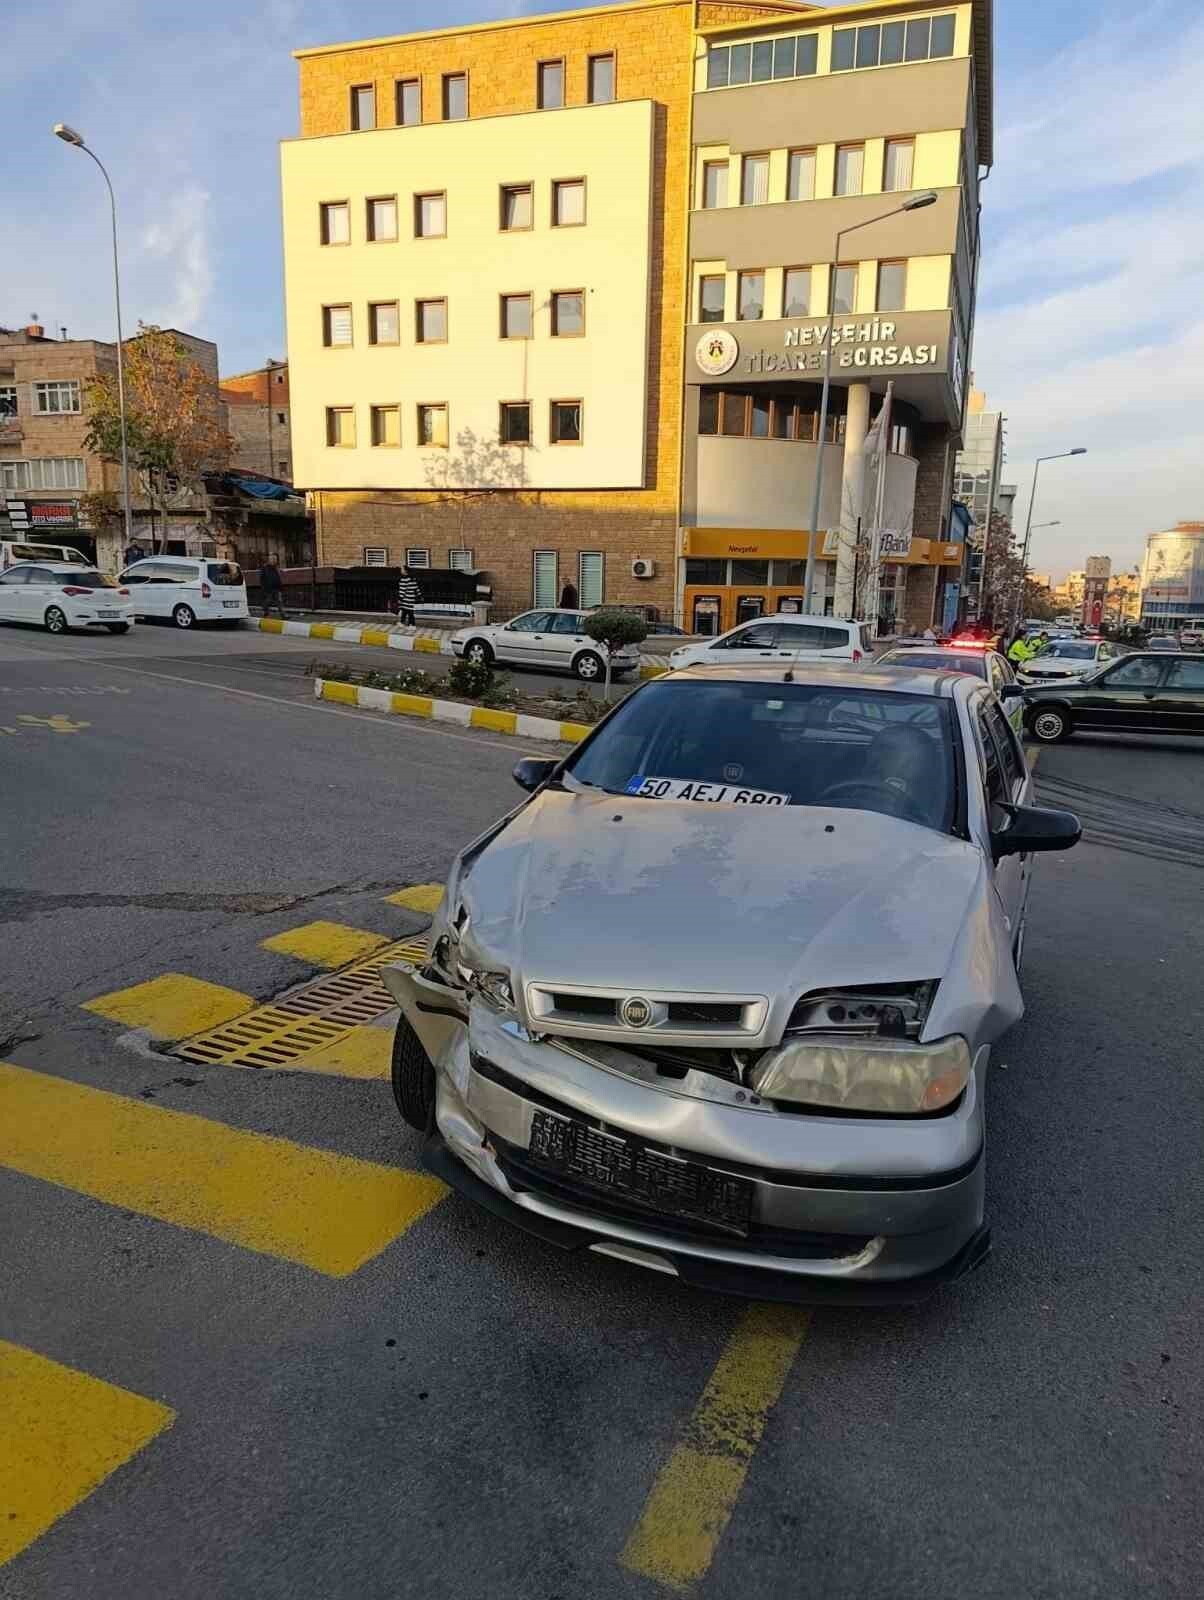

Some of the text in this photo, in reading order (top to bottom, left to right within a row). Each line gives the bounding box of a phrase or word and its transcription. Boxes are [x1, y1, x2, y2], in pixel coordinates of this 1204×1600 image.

[784, 318, 896, 347] NEVŞEHİR
[839, 347, 937, 367] BORSASI
[639, 779, 671, 797] 50
[676, 783, 727, 803] AEJ
[628, 1007, 646, 1018] FIAT
